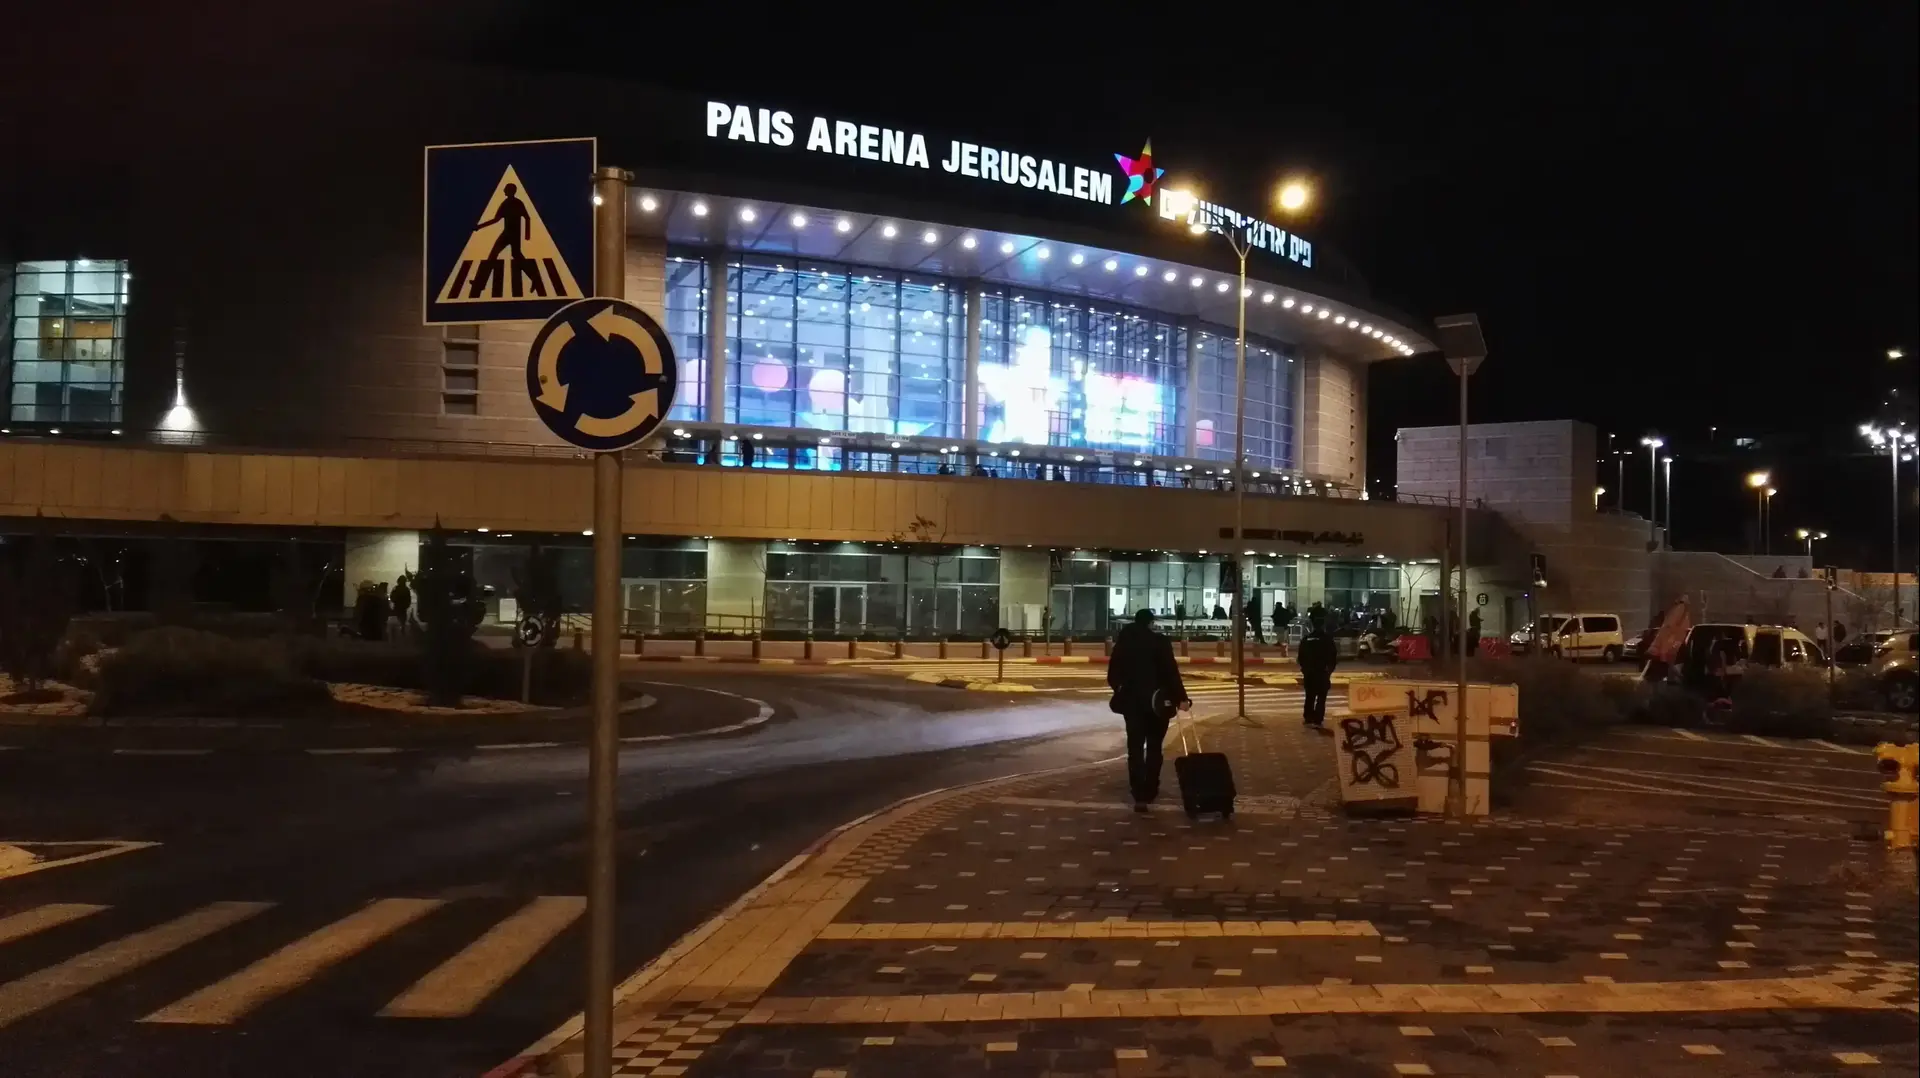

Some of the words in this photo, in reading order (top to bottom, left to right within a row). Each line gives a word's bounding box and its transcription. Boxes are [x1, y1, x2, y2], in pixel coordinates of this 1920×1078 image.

[706, 101, 795, 147] PAIS
[806, 116, 929, 170] ARENA
[941, 139, 1112, 206] JERUSALEM
[1289, 233, 1312, 269] פיס
